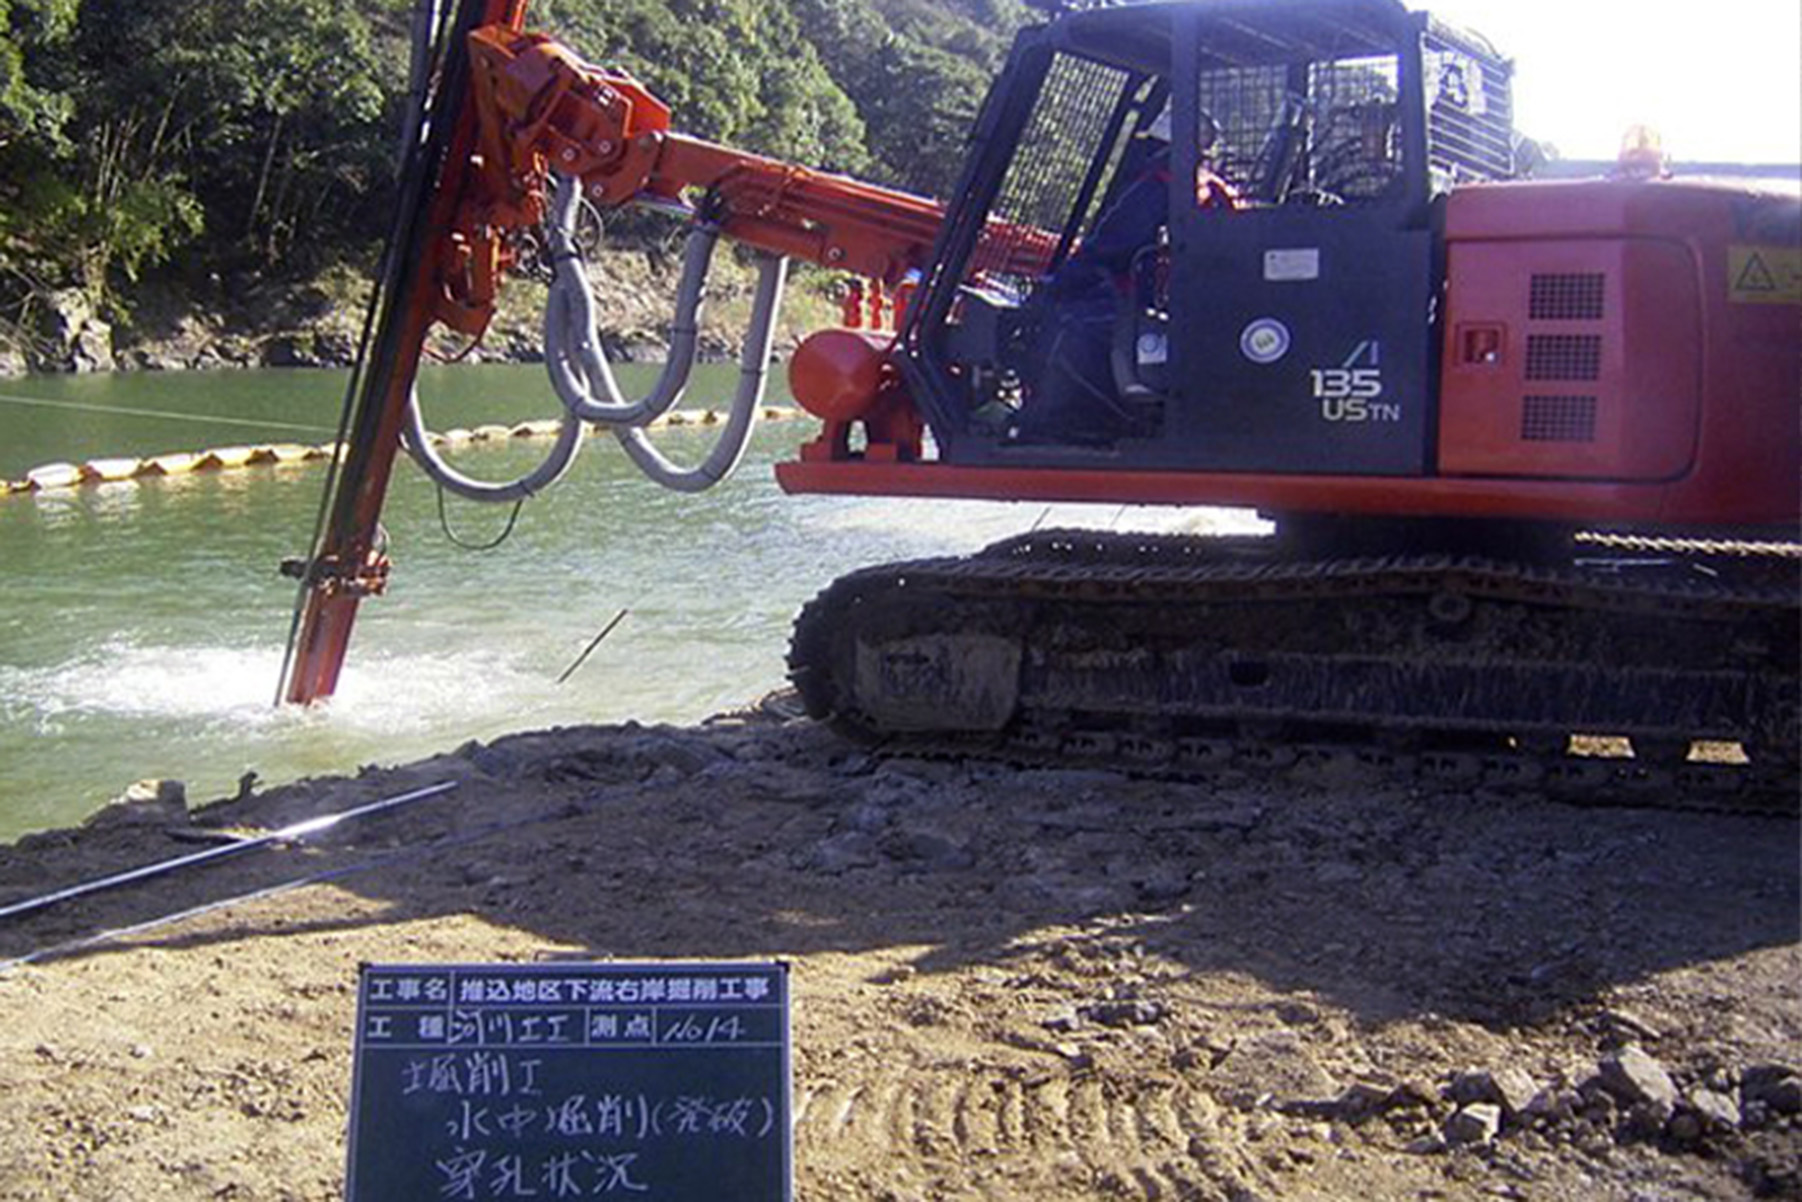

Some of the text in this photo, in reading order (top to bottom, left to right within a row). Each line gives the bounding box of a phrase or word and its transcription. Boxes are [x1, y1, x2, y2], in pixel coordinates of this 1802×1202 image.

[1310, 369, 1382, 397] 135
[1322, 399, 1400, 421] USTN
[369, 978, 448, 1000] 工事名
[591, 1013, 650, 1038] 測点
